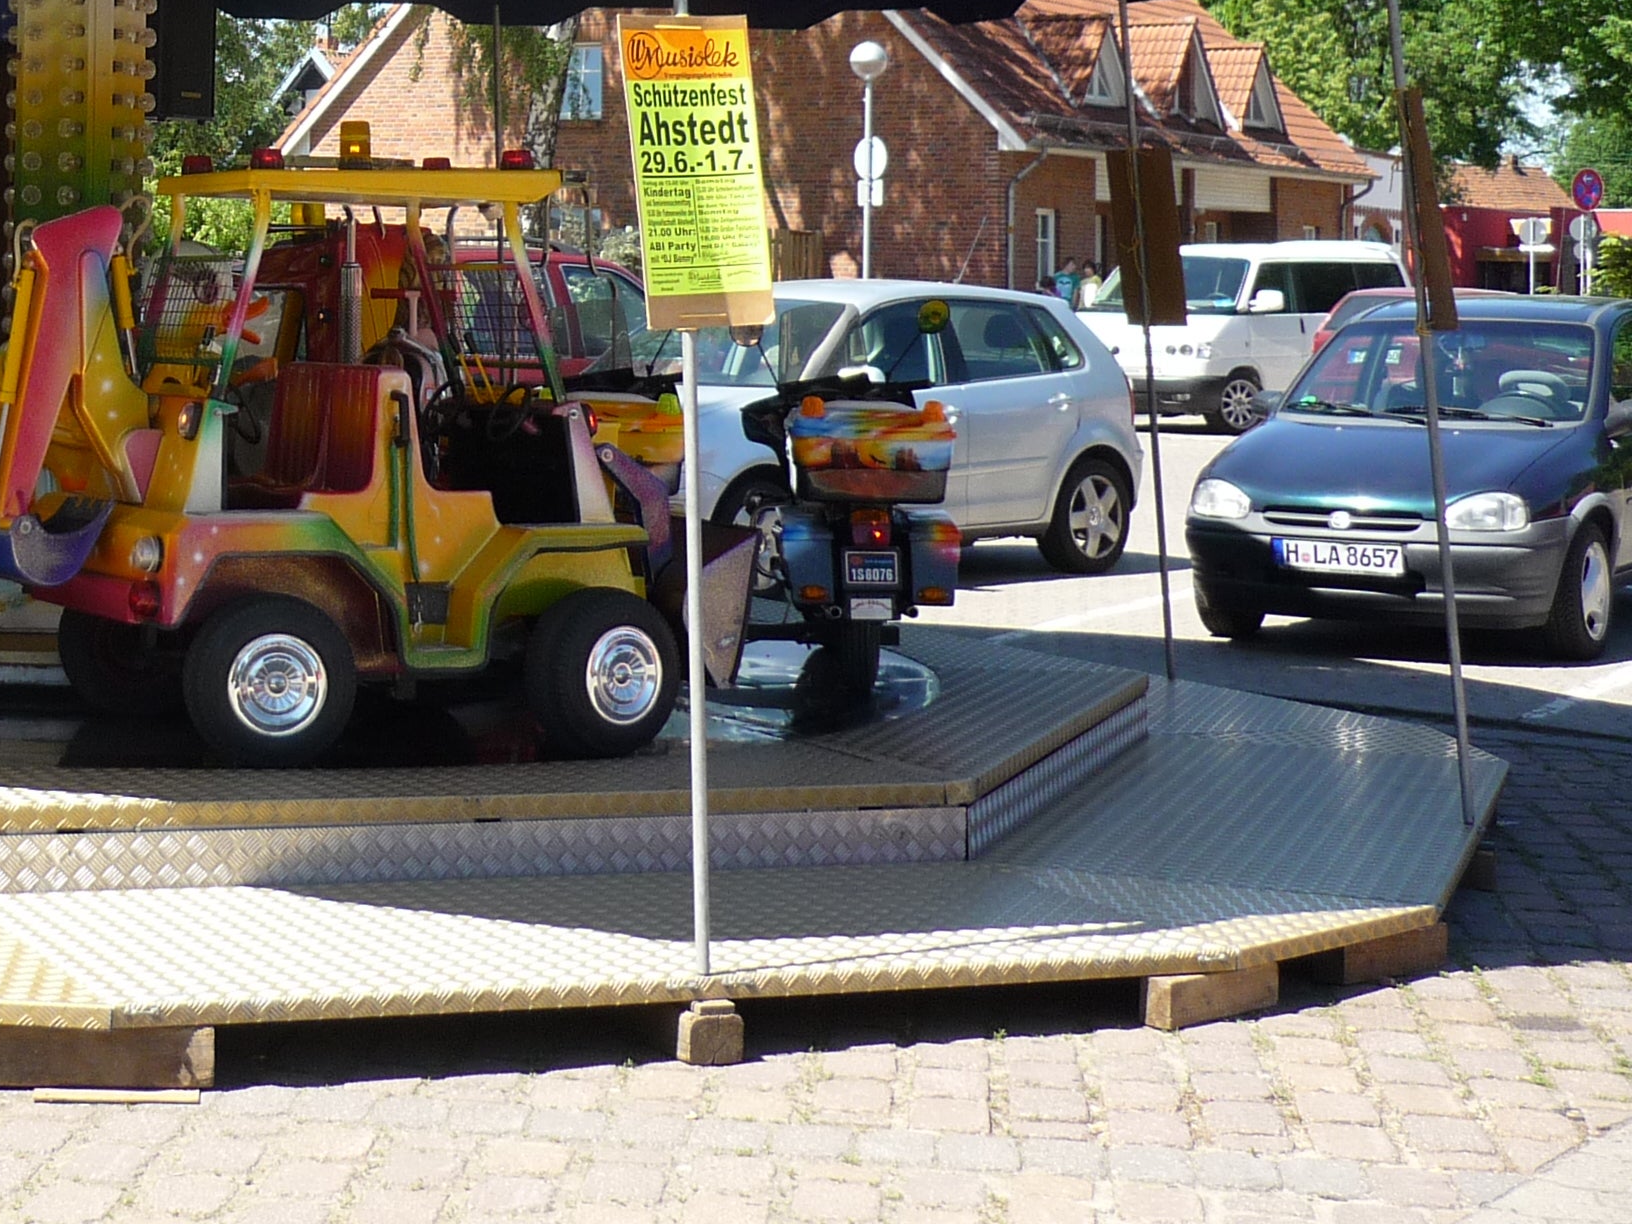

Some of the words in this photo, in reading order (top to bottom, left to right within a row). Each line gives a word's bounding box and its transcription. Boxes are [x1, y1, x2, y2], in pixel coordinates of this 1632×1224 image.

[633, 82, 746, 108] Schützenfest
[639, 110, 750, 146] Ahstedt
[641, 150, 754, 173] 29.6.-1.7.
[643, 187, 691, 199] Kindertag
[648, 227, 672, 237] 21.00
[649, 242, 665, 251] ABI
[668, 241, 697, 252] Party
[1286, 543, 1299, 563] H
[1313, 544, 1341, 565] LA
[1347, 546, 1399, 568] 8657
